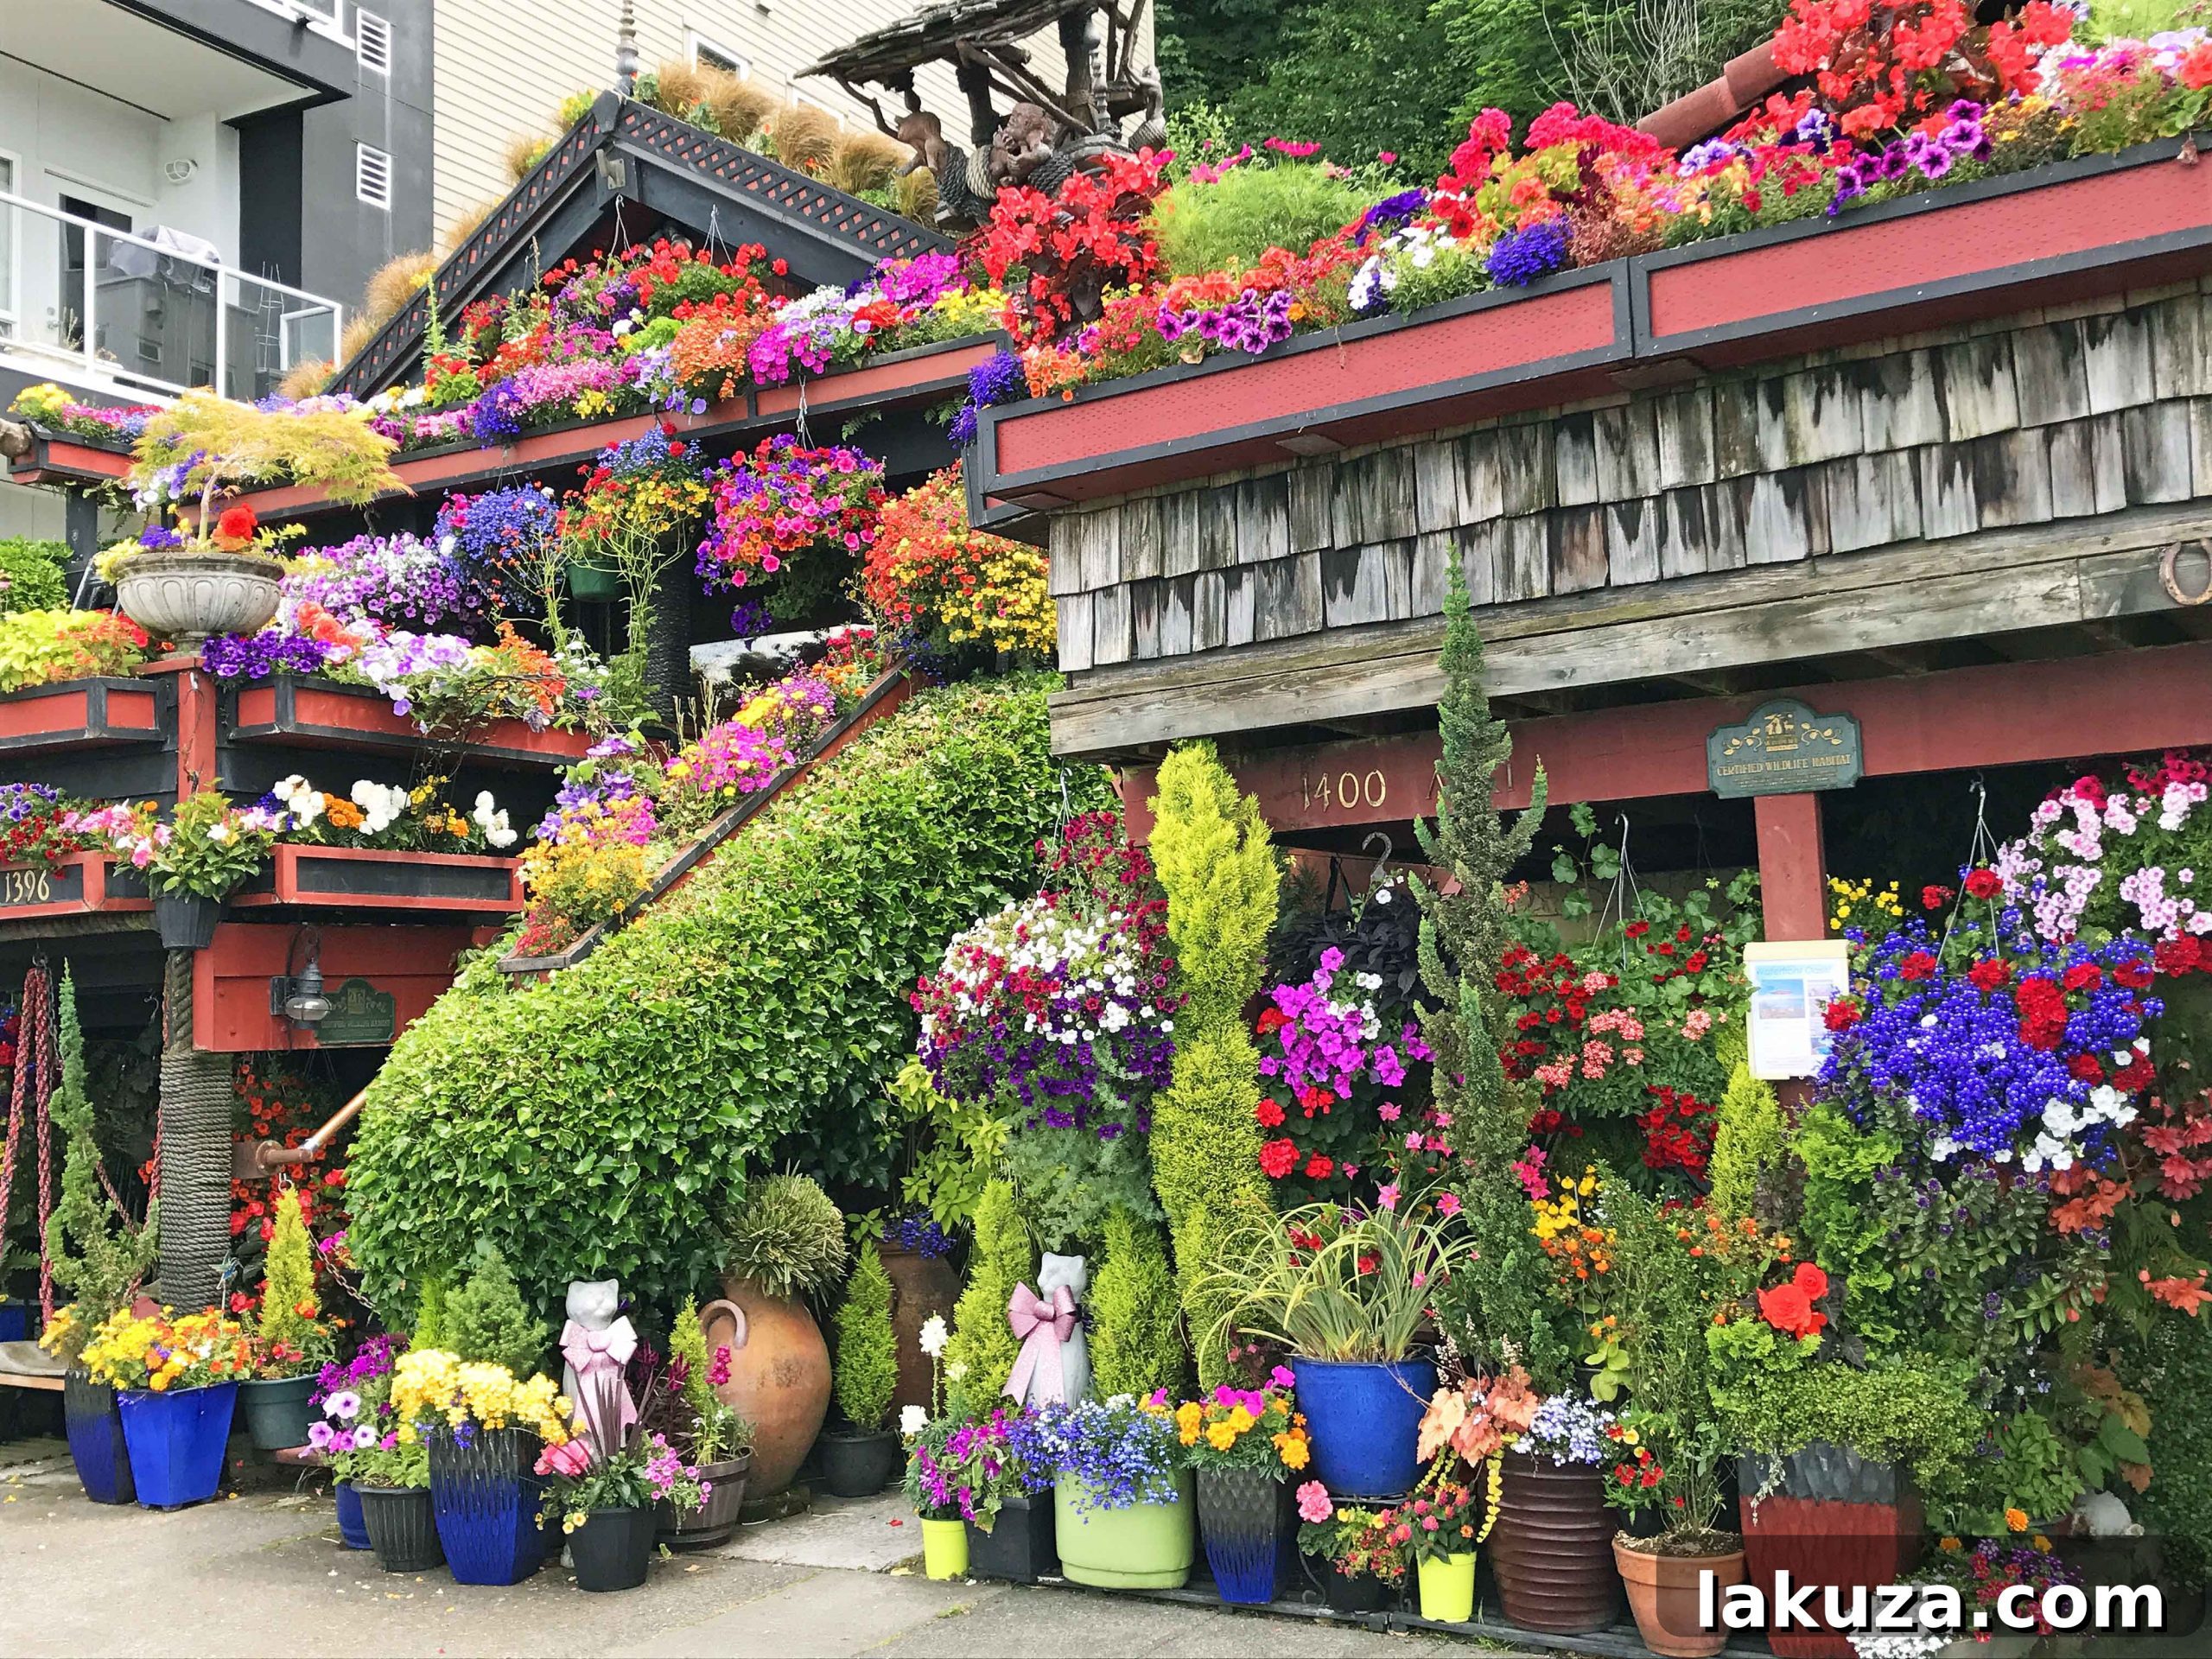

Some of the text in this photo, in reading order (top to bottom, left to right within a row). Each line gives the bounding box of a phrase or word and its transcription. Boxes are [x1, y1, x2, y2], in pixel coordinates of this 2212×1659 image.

[1718, 754, 1852, 777] CERTIFIED WILDLIFE HABITAT
[1303, 769, 1387, 811] 1400
[5, 869, 50, 903] 1396
